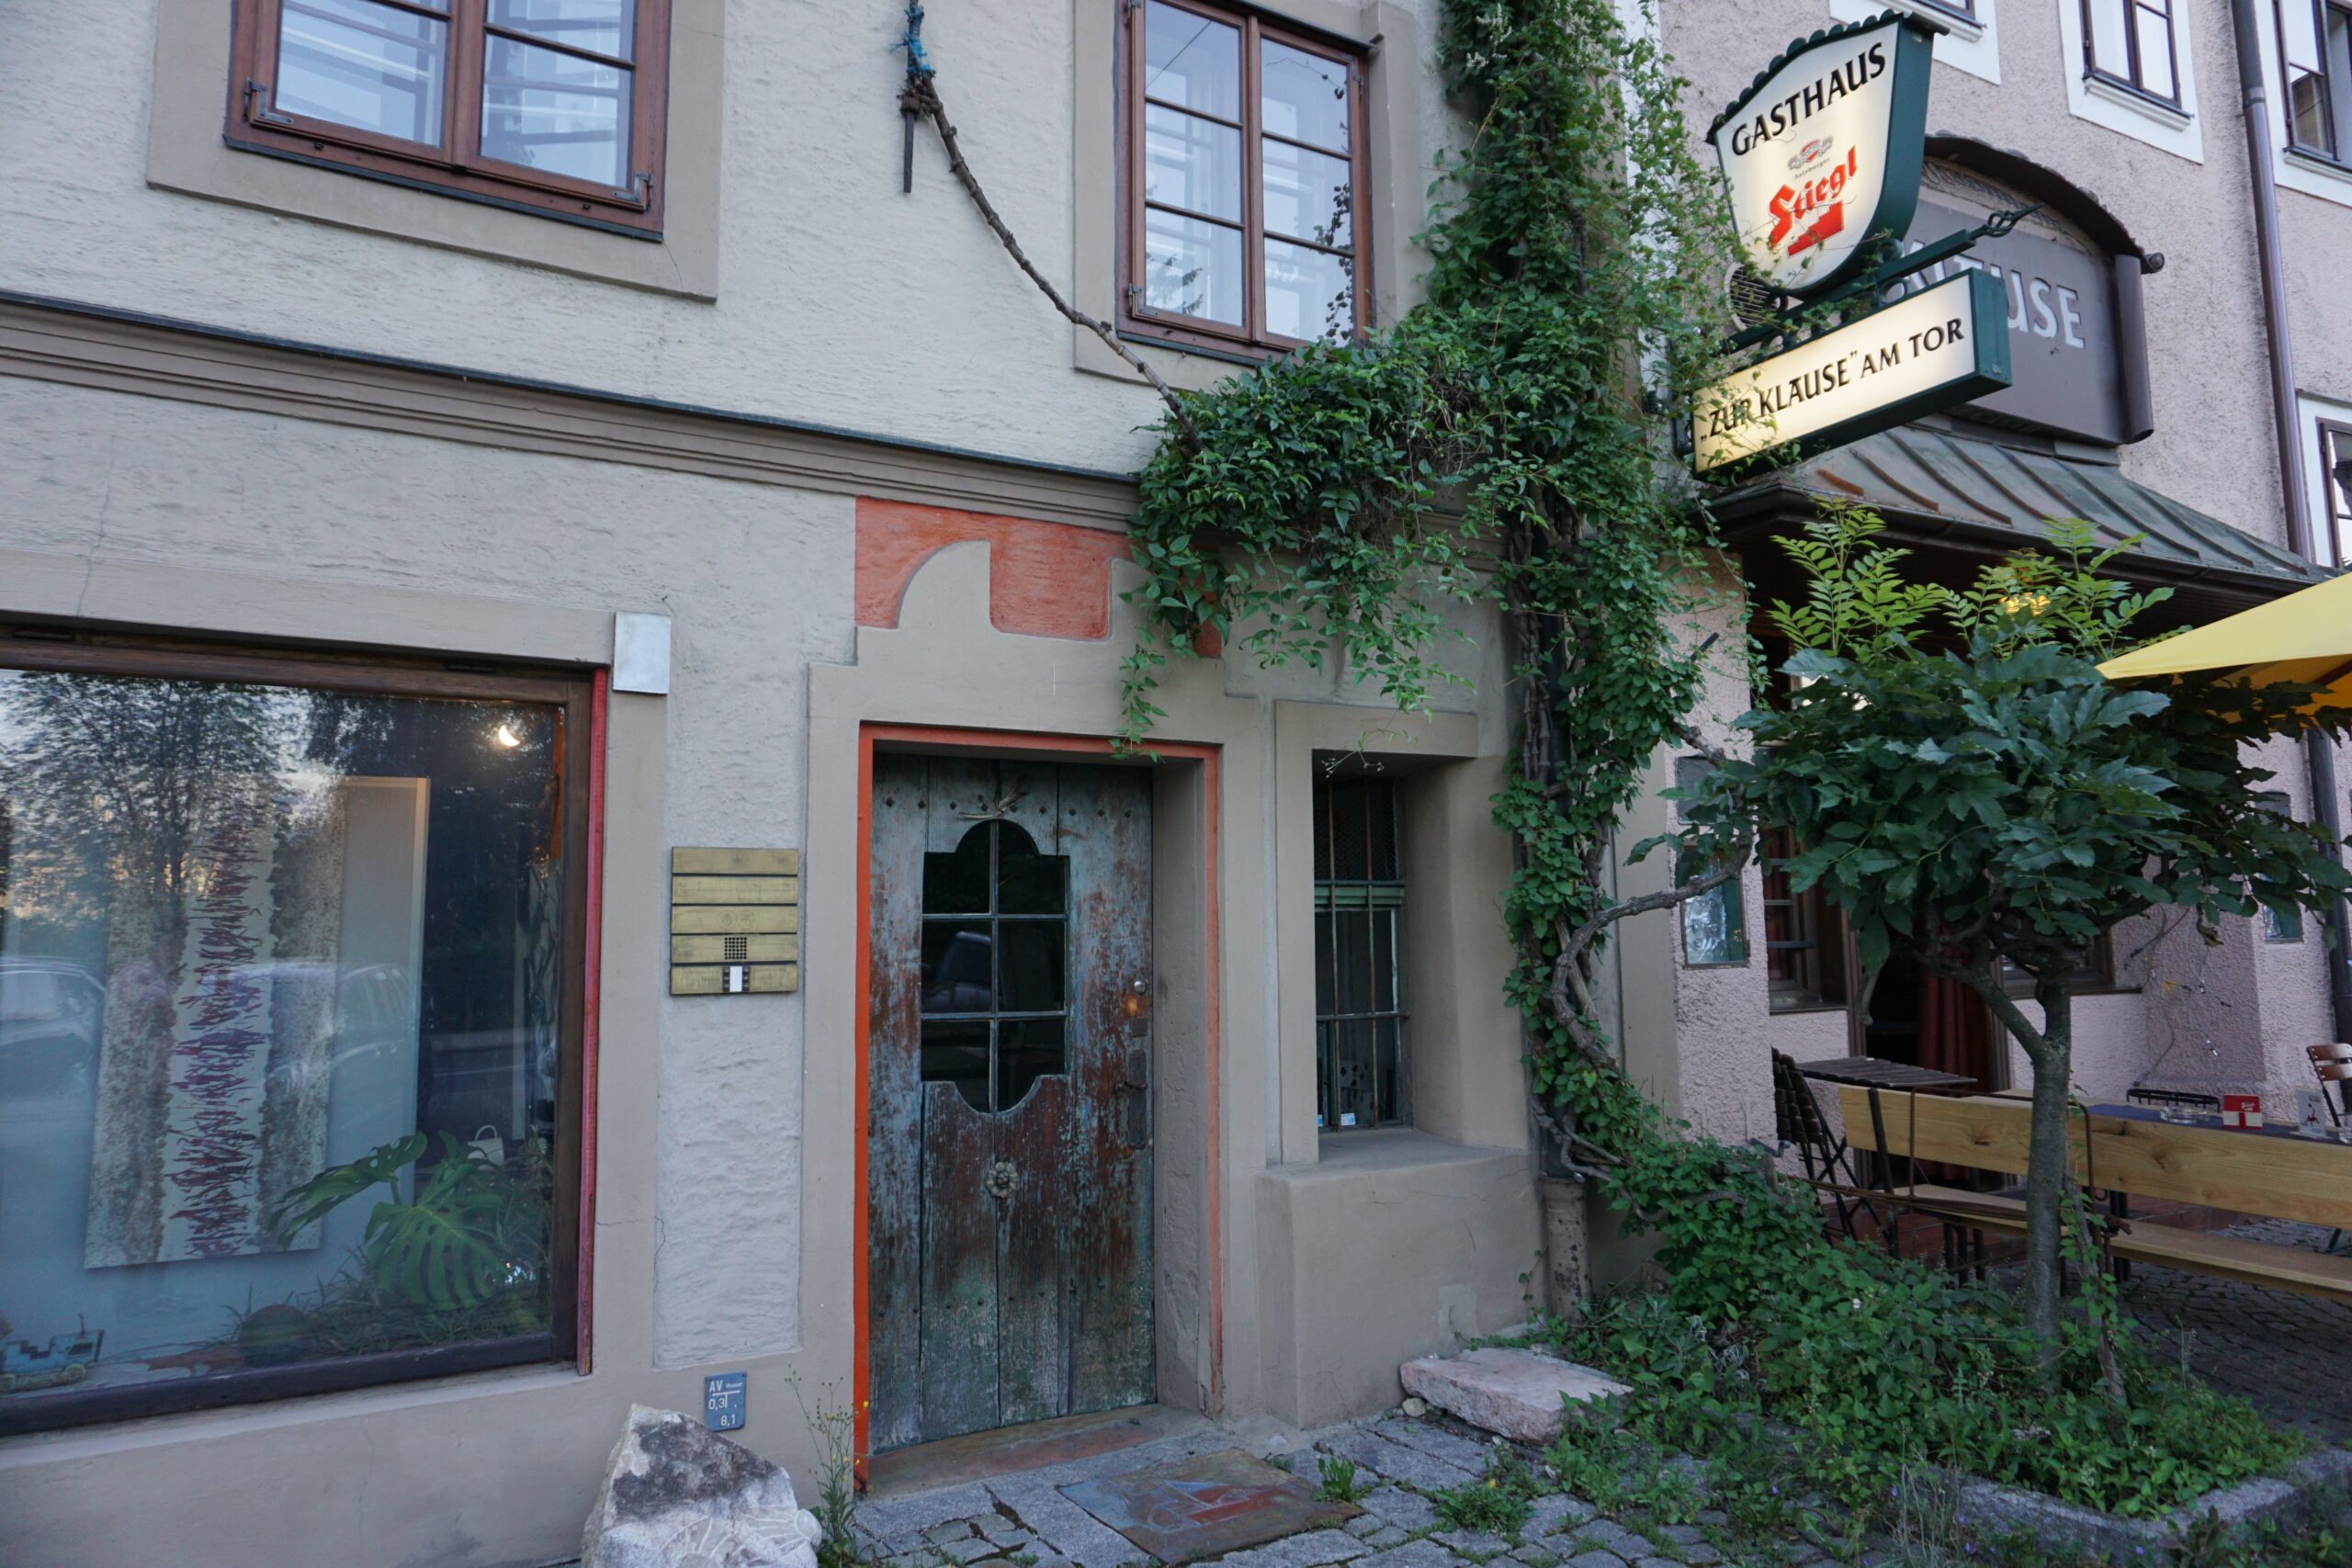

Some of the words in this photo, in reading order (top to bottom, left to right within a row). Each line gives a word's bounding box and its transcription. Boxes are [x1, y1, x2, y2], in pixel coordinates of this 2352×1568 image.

[1732, 42, 1886, 156] GASTHAUS
[1769, 144, 1858, 251] Stiegl
[1860, 343, 1902, 378] AM
[1908, 318, 1964, 358] TOR
[708, 1380, 723, 1393] AV
[720, 1414, 735, 1427] 8,1
